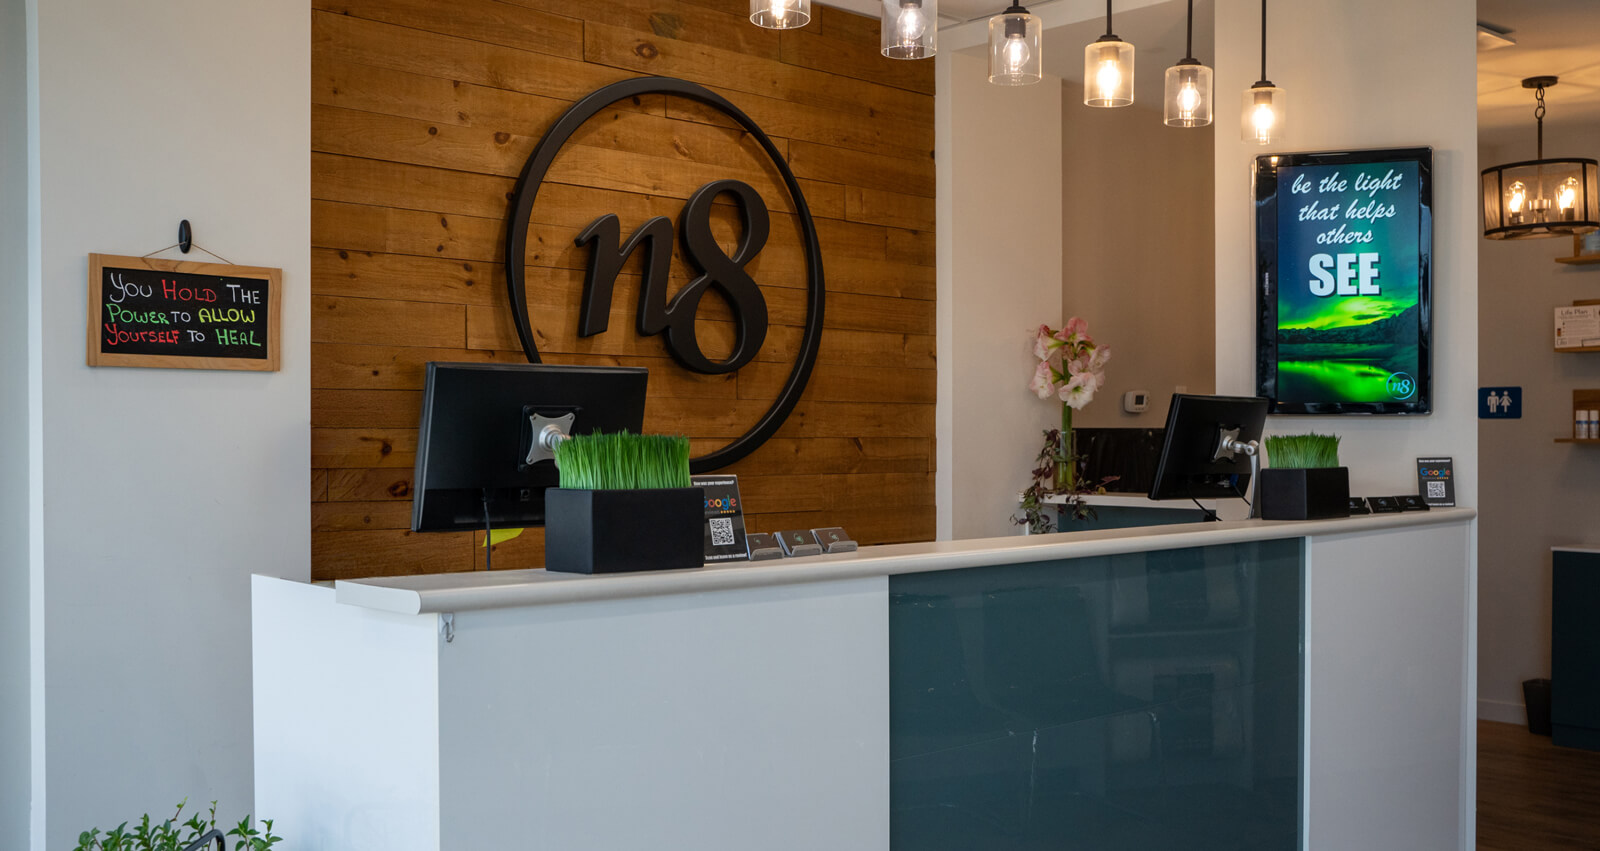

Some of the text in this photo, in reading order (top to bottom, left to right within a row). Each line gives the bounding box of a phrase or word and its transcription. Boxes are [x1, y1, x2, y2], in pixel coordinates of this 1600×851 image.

[1291, 169, 1403, 197] be the light
[1298, 199, 1397, 224] that helps
[1316, 224, 1374, 244] others
[574, 179, 770, 375] n8
[1309, 252, 1381, 297] SEE
[109, 272, 261, 304] YOU HOLD THE
[106, 303, 256, 325] POWER TO ALLOW
[186, 329, 206, 342] TO
[215, 328, 262, 347] HEAL
[1392, 379, 1410, 394] n8
[1420, 467, 1450, 477] Google
